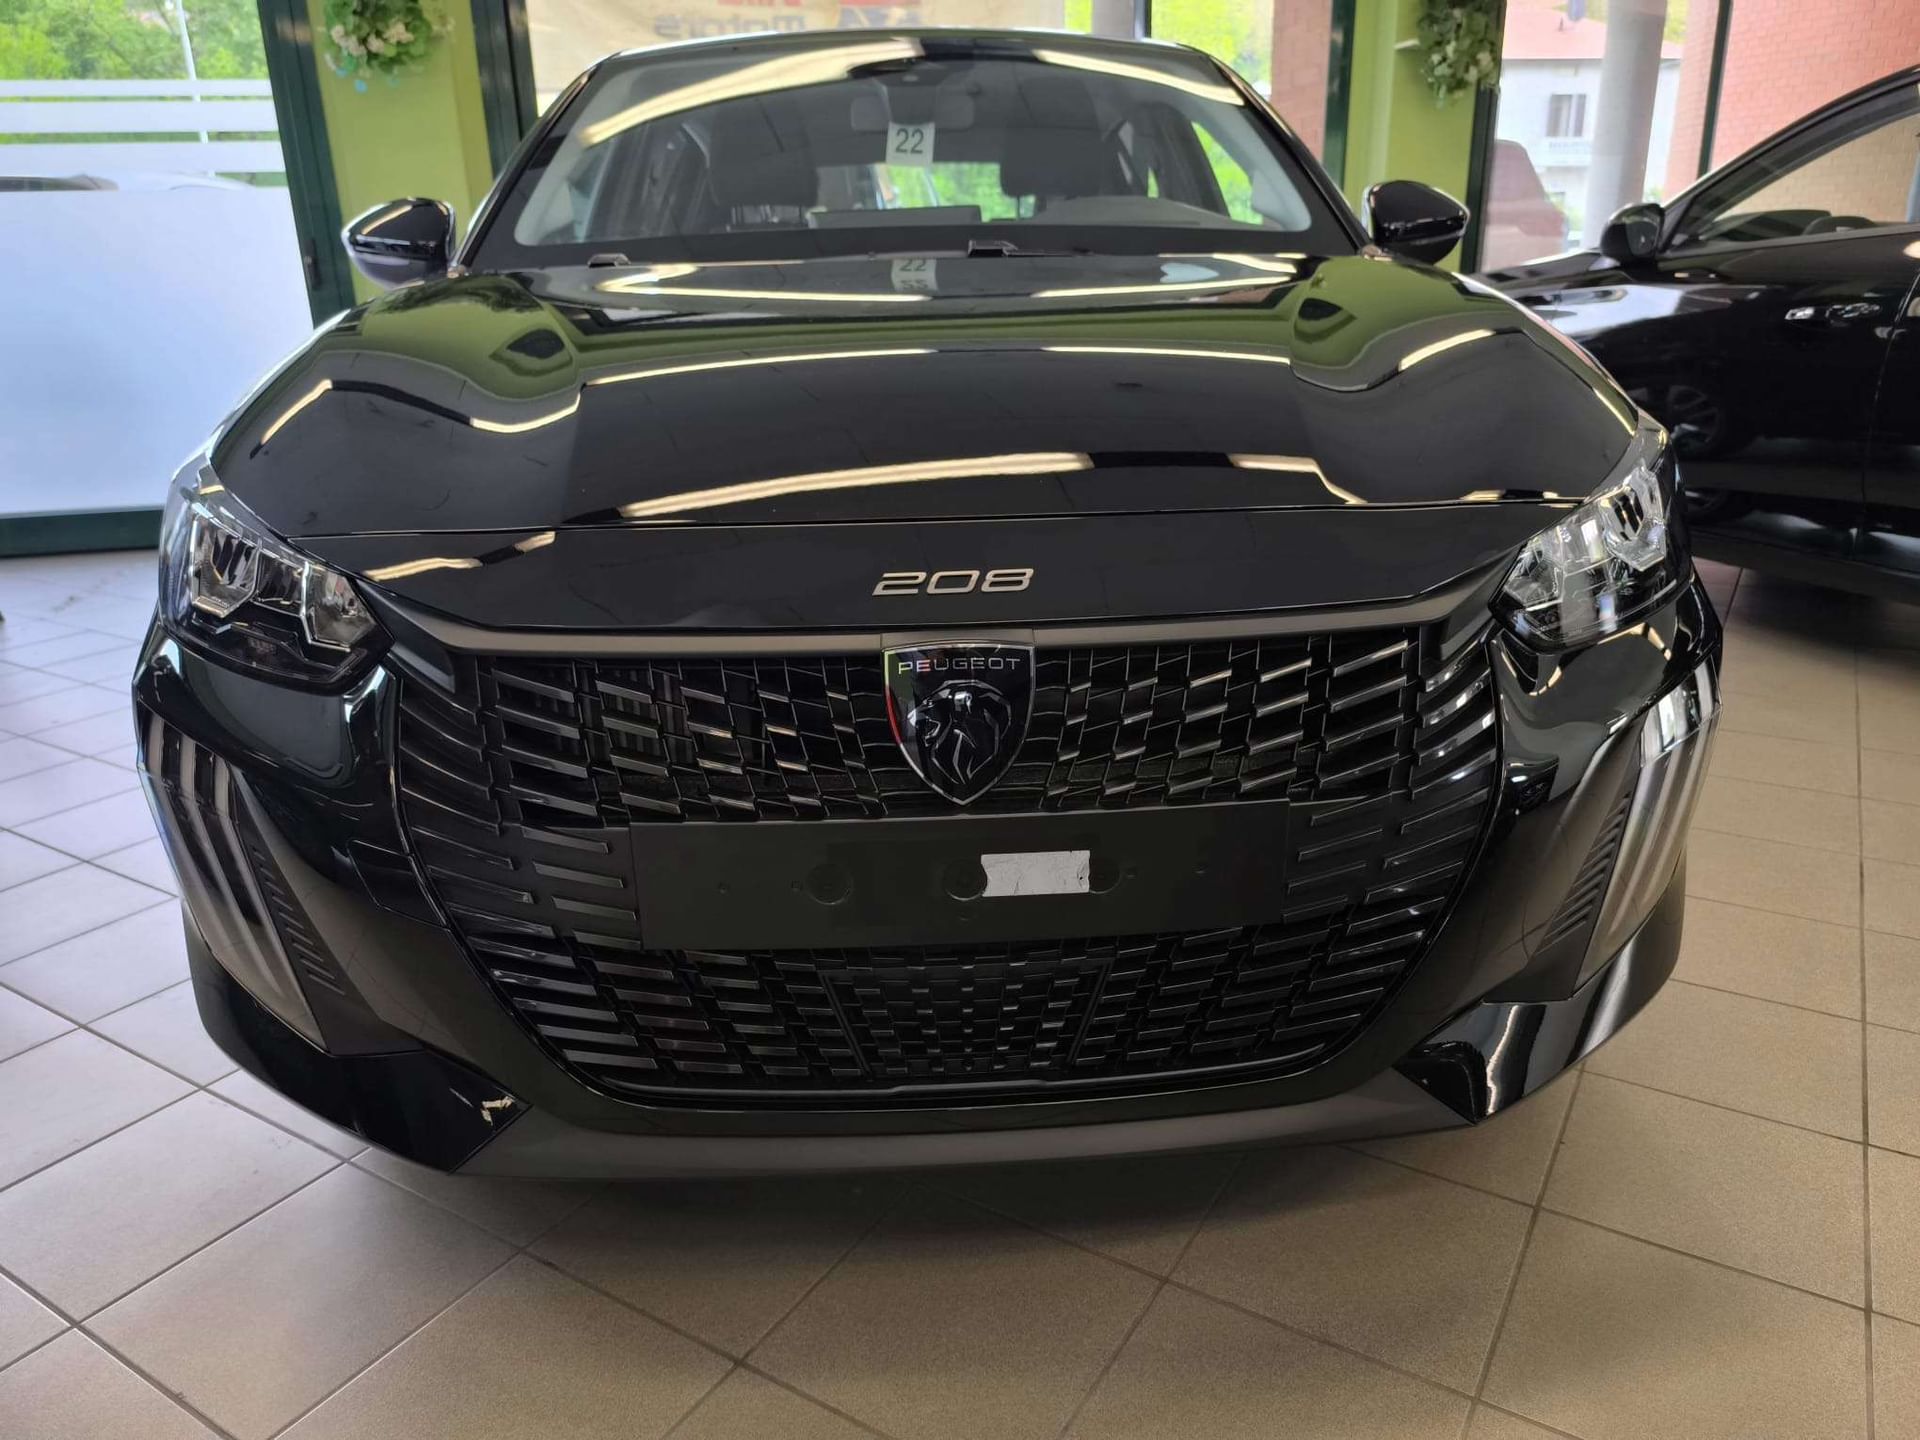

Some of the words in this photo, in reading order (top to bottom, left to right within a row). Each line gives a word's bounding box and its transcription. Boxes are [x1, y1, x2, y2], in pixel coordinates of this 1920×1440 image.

[895, 127, 924, 154] 22
[872, 568, 1034, 596] 208
[898, 657, 1021, 675] PEUGEOT
